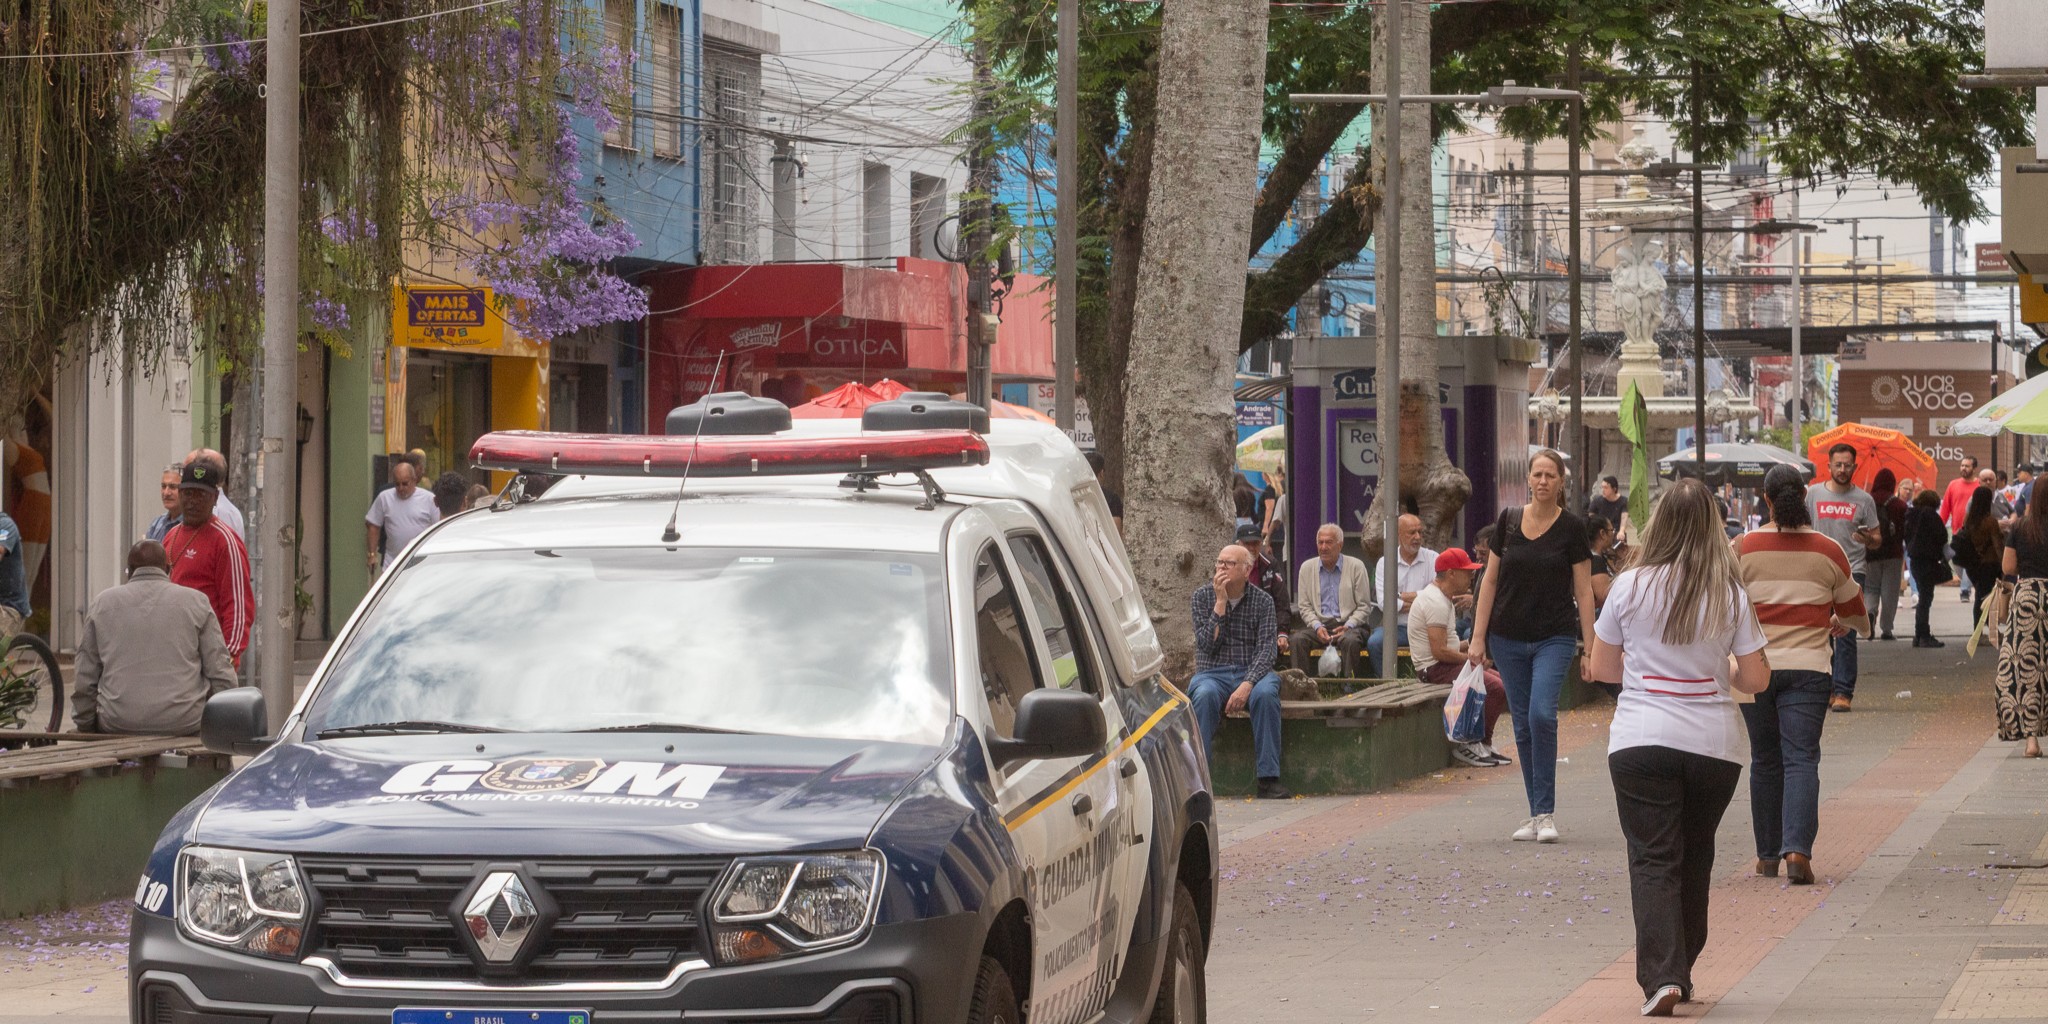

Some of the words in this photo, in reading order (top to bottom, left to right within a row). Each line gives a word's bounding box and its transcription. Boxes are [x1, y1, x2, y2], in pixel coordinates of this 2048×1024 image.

[424, 295, 469, 310] MAIS
[416, 310, 478, 321] OFERTAS
[813, 335, 898, 356] ÓTICA
[1038, 384, 1056, 399] Sa
[1854, 426, 1891, 439] pontofrio
[366, 793, 541, 804] POLICIAMENTO
[547, 793, 700, 810] PREVENTIVO
[1042, 841, 1091, 911] GUARDA
[143, 881, 169, 913] 10
[474, 1016, 505, 1024] BRASIL
